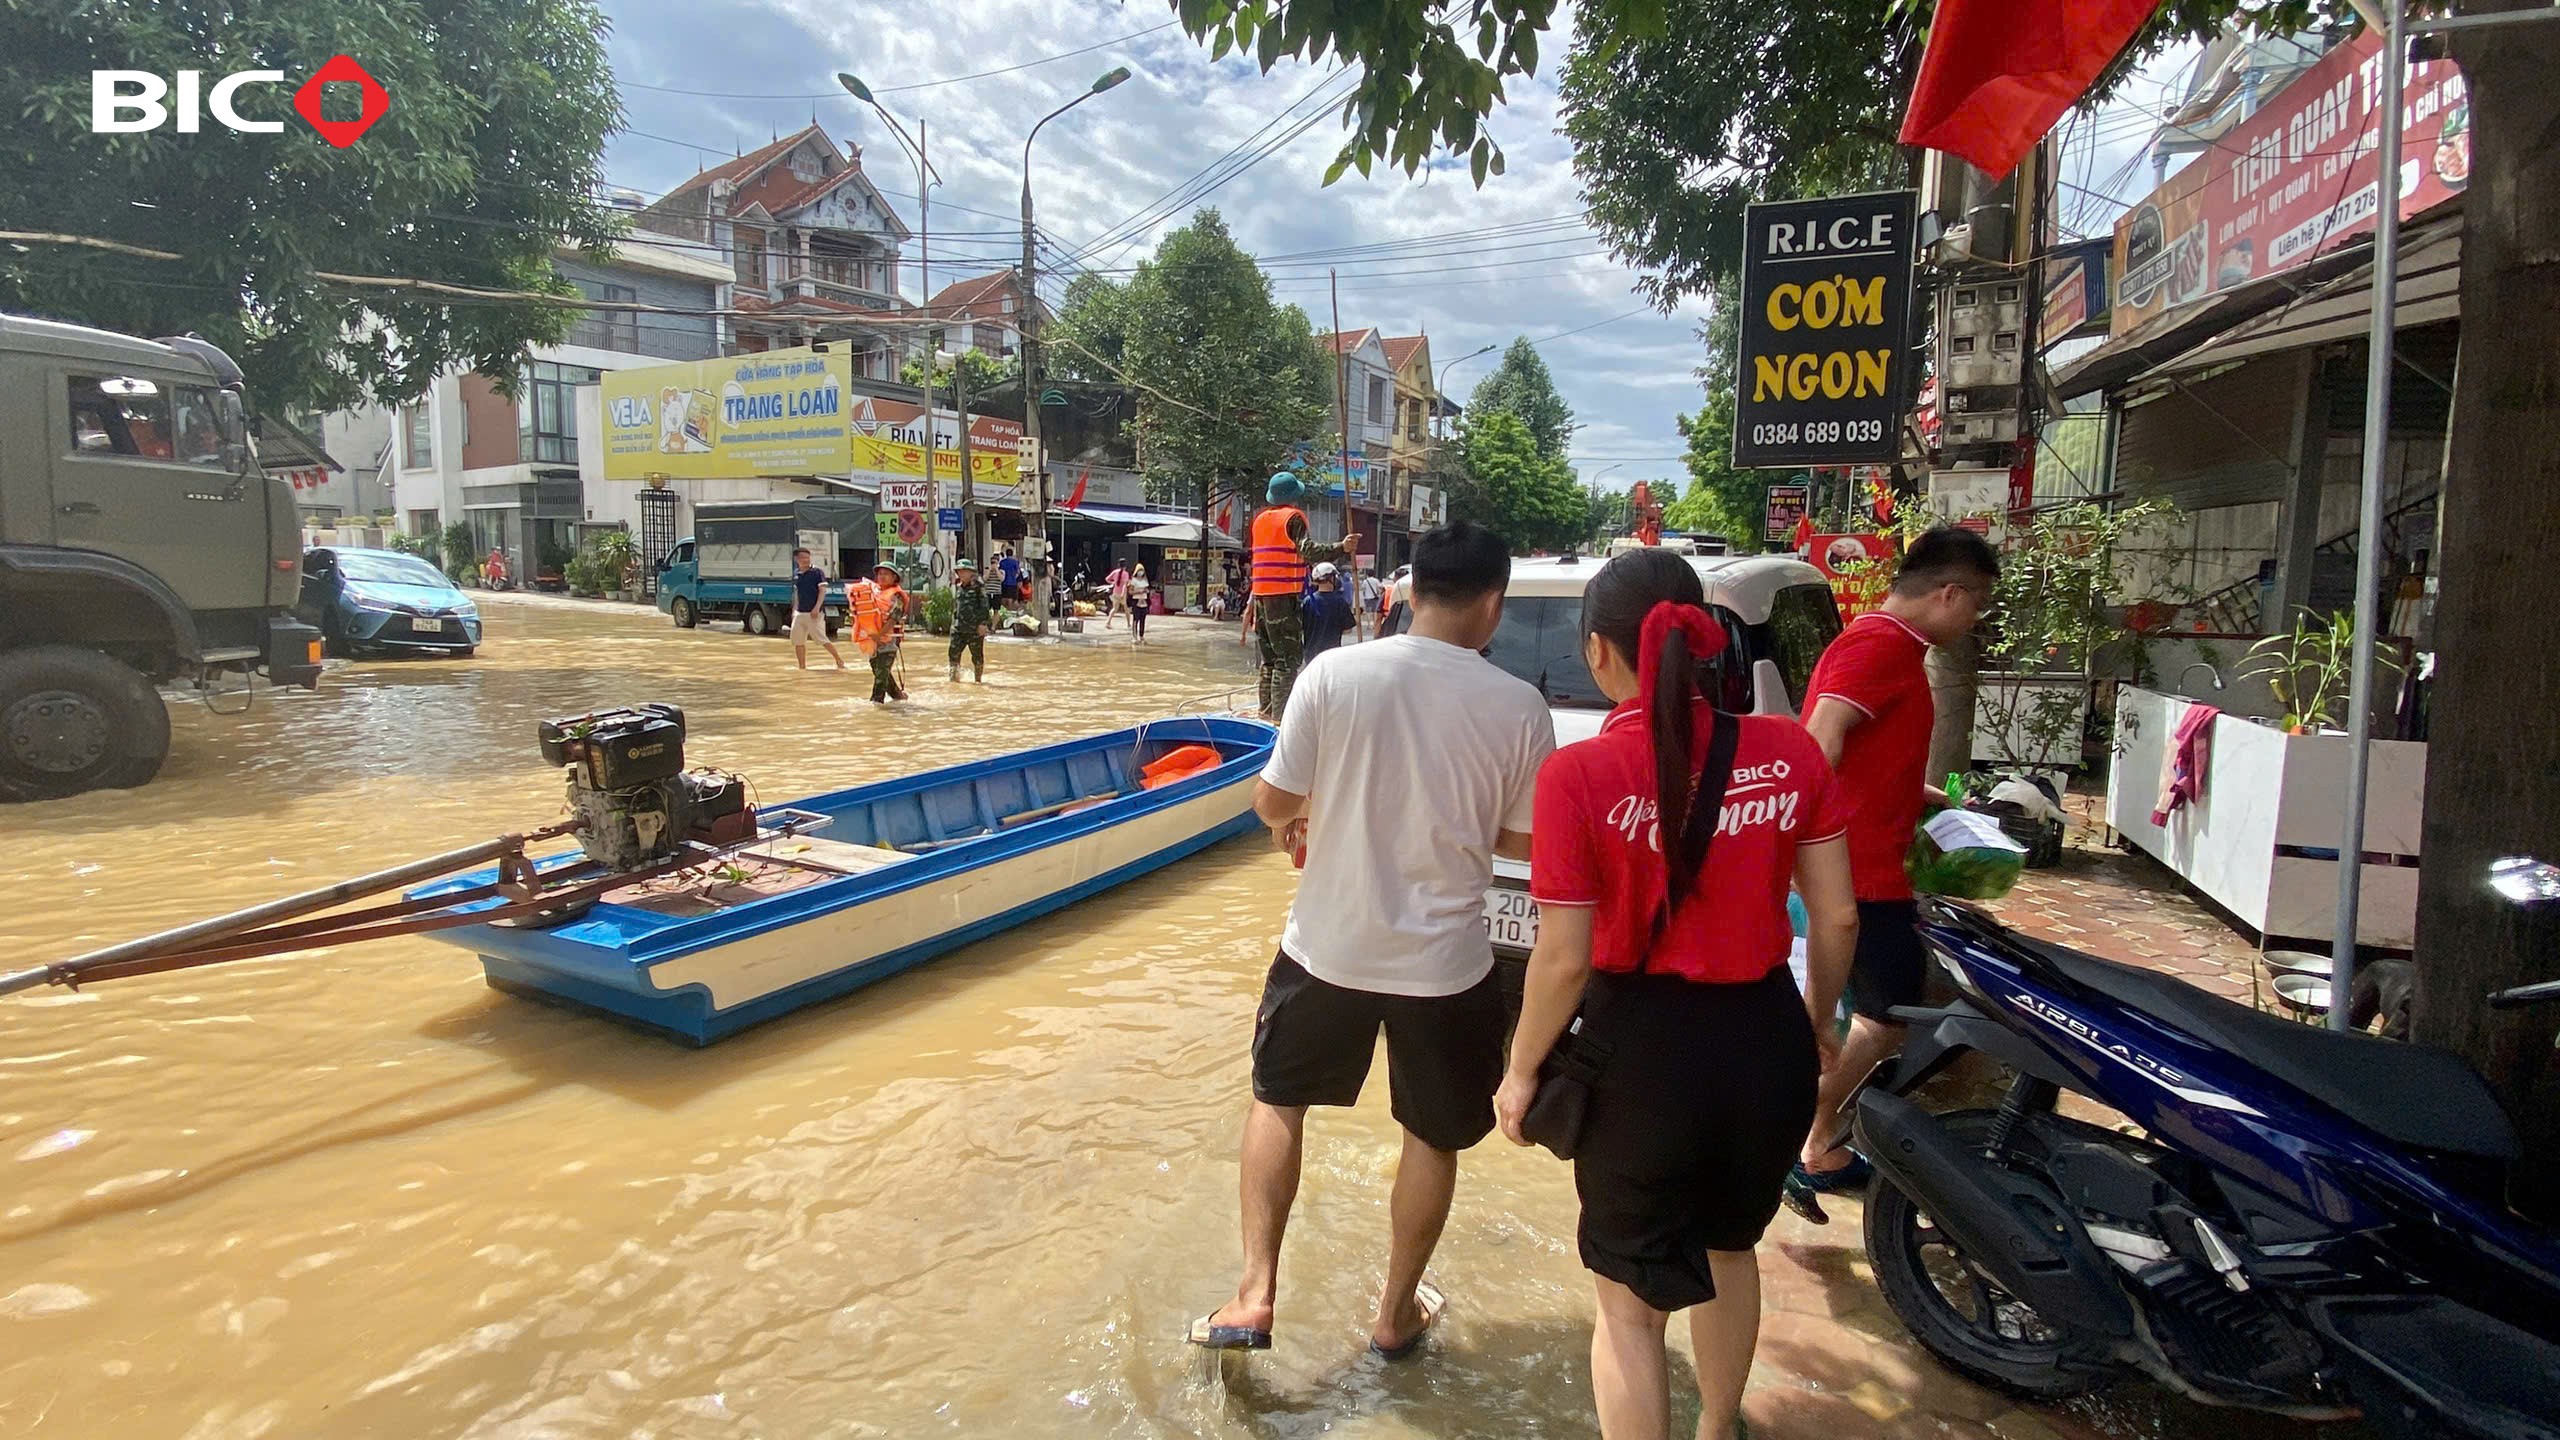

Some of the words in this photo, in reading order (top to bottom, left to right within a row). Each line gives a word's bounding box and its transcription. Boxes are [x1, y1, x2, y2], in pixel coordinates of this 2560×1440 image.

[2232, 127, 2282, 204] TIỆM
[2289, 73, 2351, 165] QUAY
[1767, 213, 1895, 255] R.I.C.E
[2277, 234, 2299, 257] Liên
[2354, 188, 2376, 215] 278
[1766, 273, 1887, 331] CƠM
[1752, 349, 1891, 402] NGON
[609, 397, 653, 429] VELA
[725, 394, 782, 424] TRANG
[788, 388, 839, 417] LOAN
[891, 427, 917, 446] BIA
[969, 435, 998, 448] TRANG
[1752, 422, 1799, 446] 0384
[1803, 421, 1841, 443] 689
[1845, 419, 1883, 442] 039
[892, 485, 907, 497] KOI
[1732, 759, 1791, 785] BICO
[1497, 893, 1540, 921] 20A
[1482, 916, 1540, 946] 10.1
